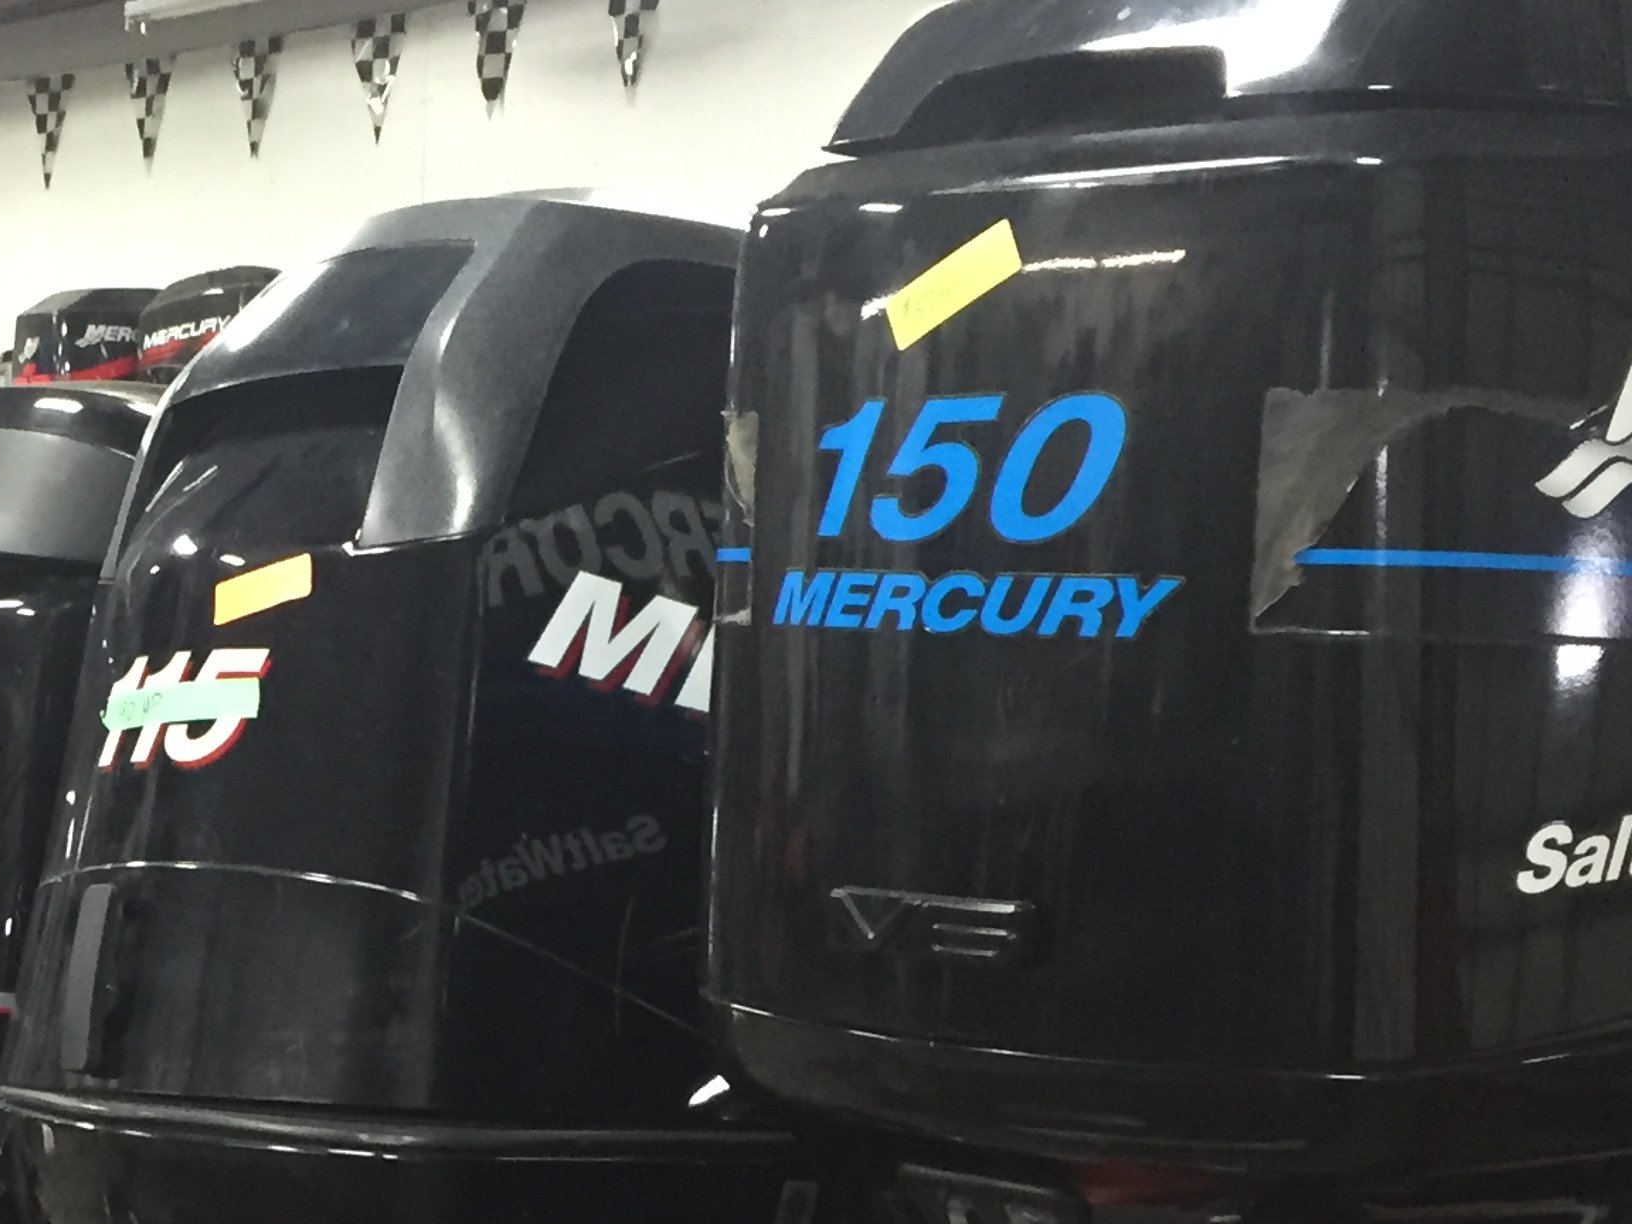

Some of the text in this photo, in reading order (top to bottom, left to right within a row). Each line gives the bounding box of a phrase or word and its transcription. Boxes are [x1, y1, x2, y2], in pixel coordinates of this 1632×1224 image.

[143, 315, 231, 350] MERCURY
[817, 392, 1127, 543] 150
[772, 568, 1186, 641] MERCURY
[98, 648, 272, 772] 115
[1516, 812, 1632, 894] Sal
